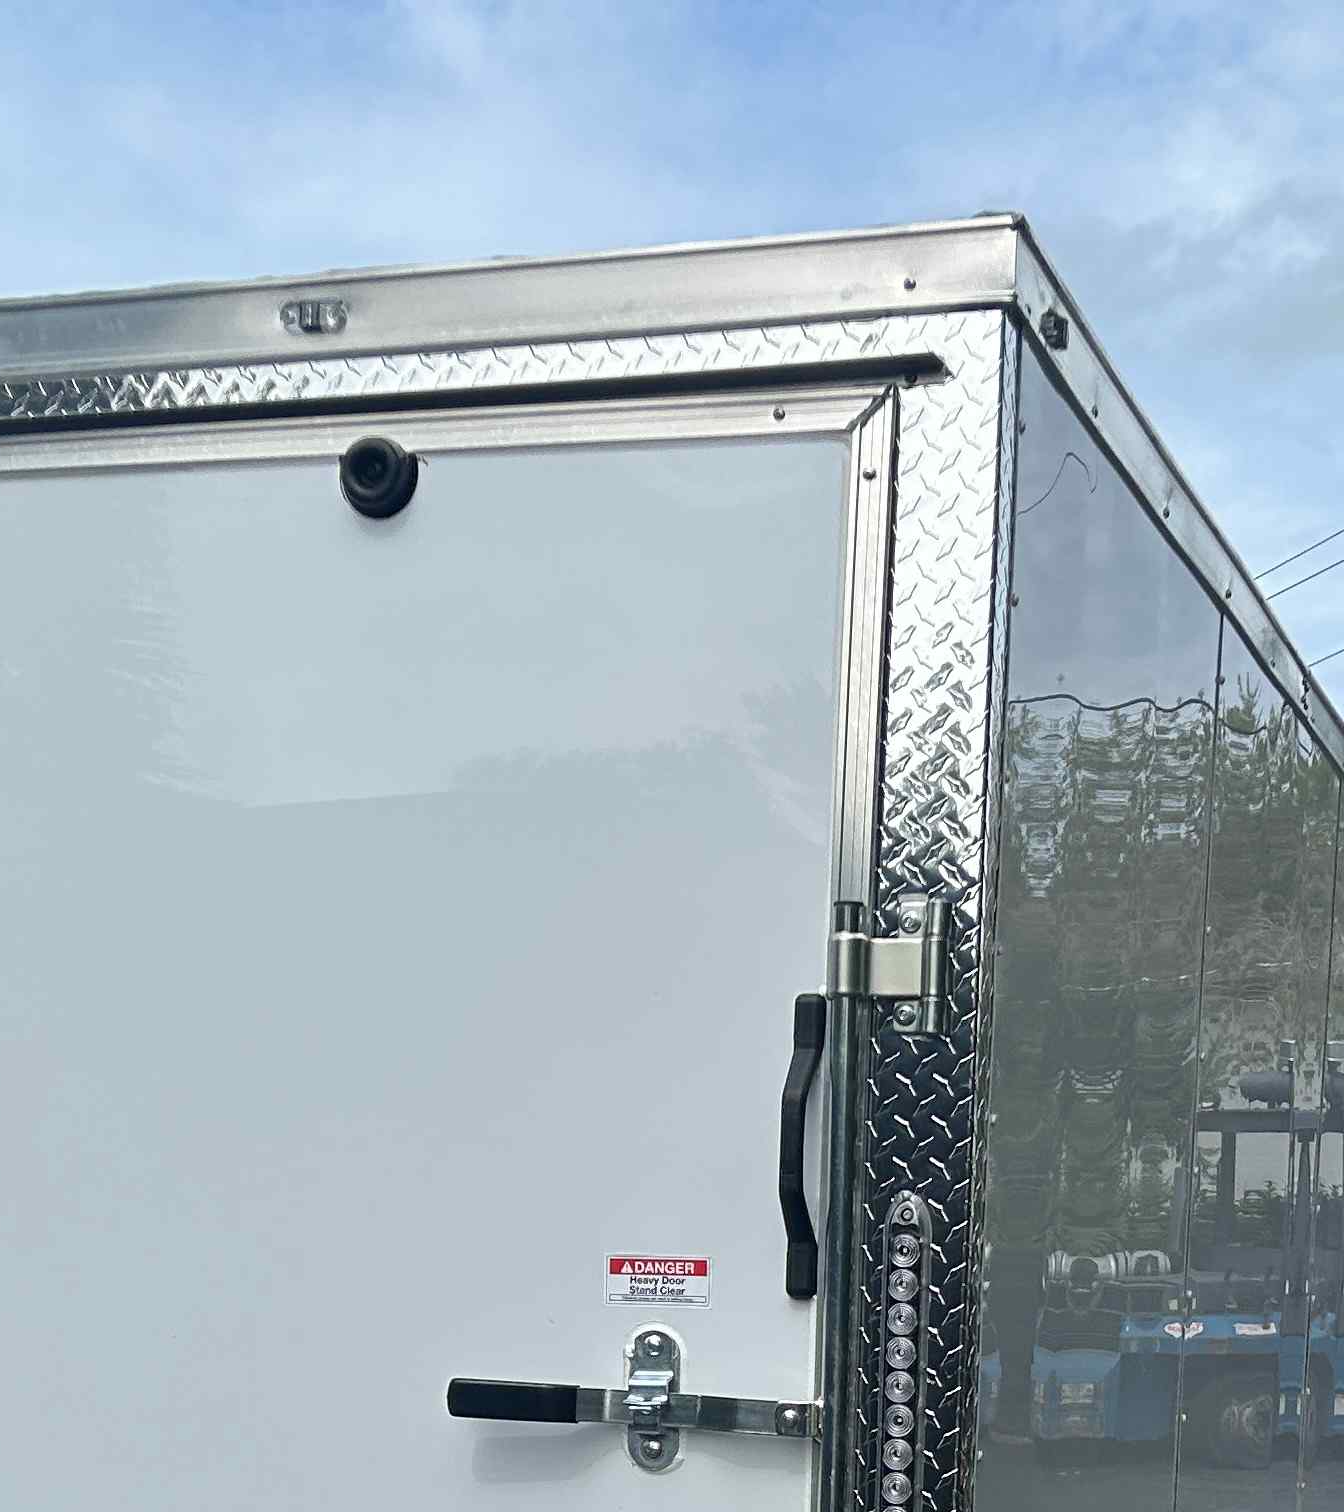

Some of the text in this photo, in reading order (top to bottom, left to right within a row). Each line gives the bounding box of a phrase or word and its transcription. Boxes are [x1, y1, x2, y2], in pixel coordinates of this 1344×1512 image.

[634, 1262, 695, 1275] DANGER
[629, 1276, 686, 1287] Heavy Door
[629, 1286, 686, 1296] Stand Clear
